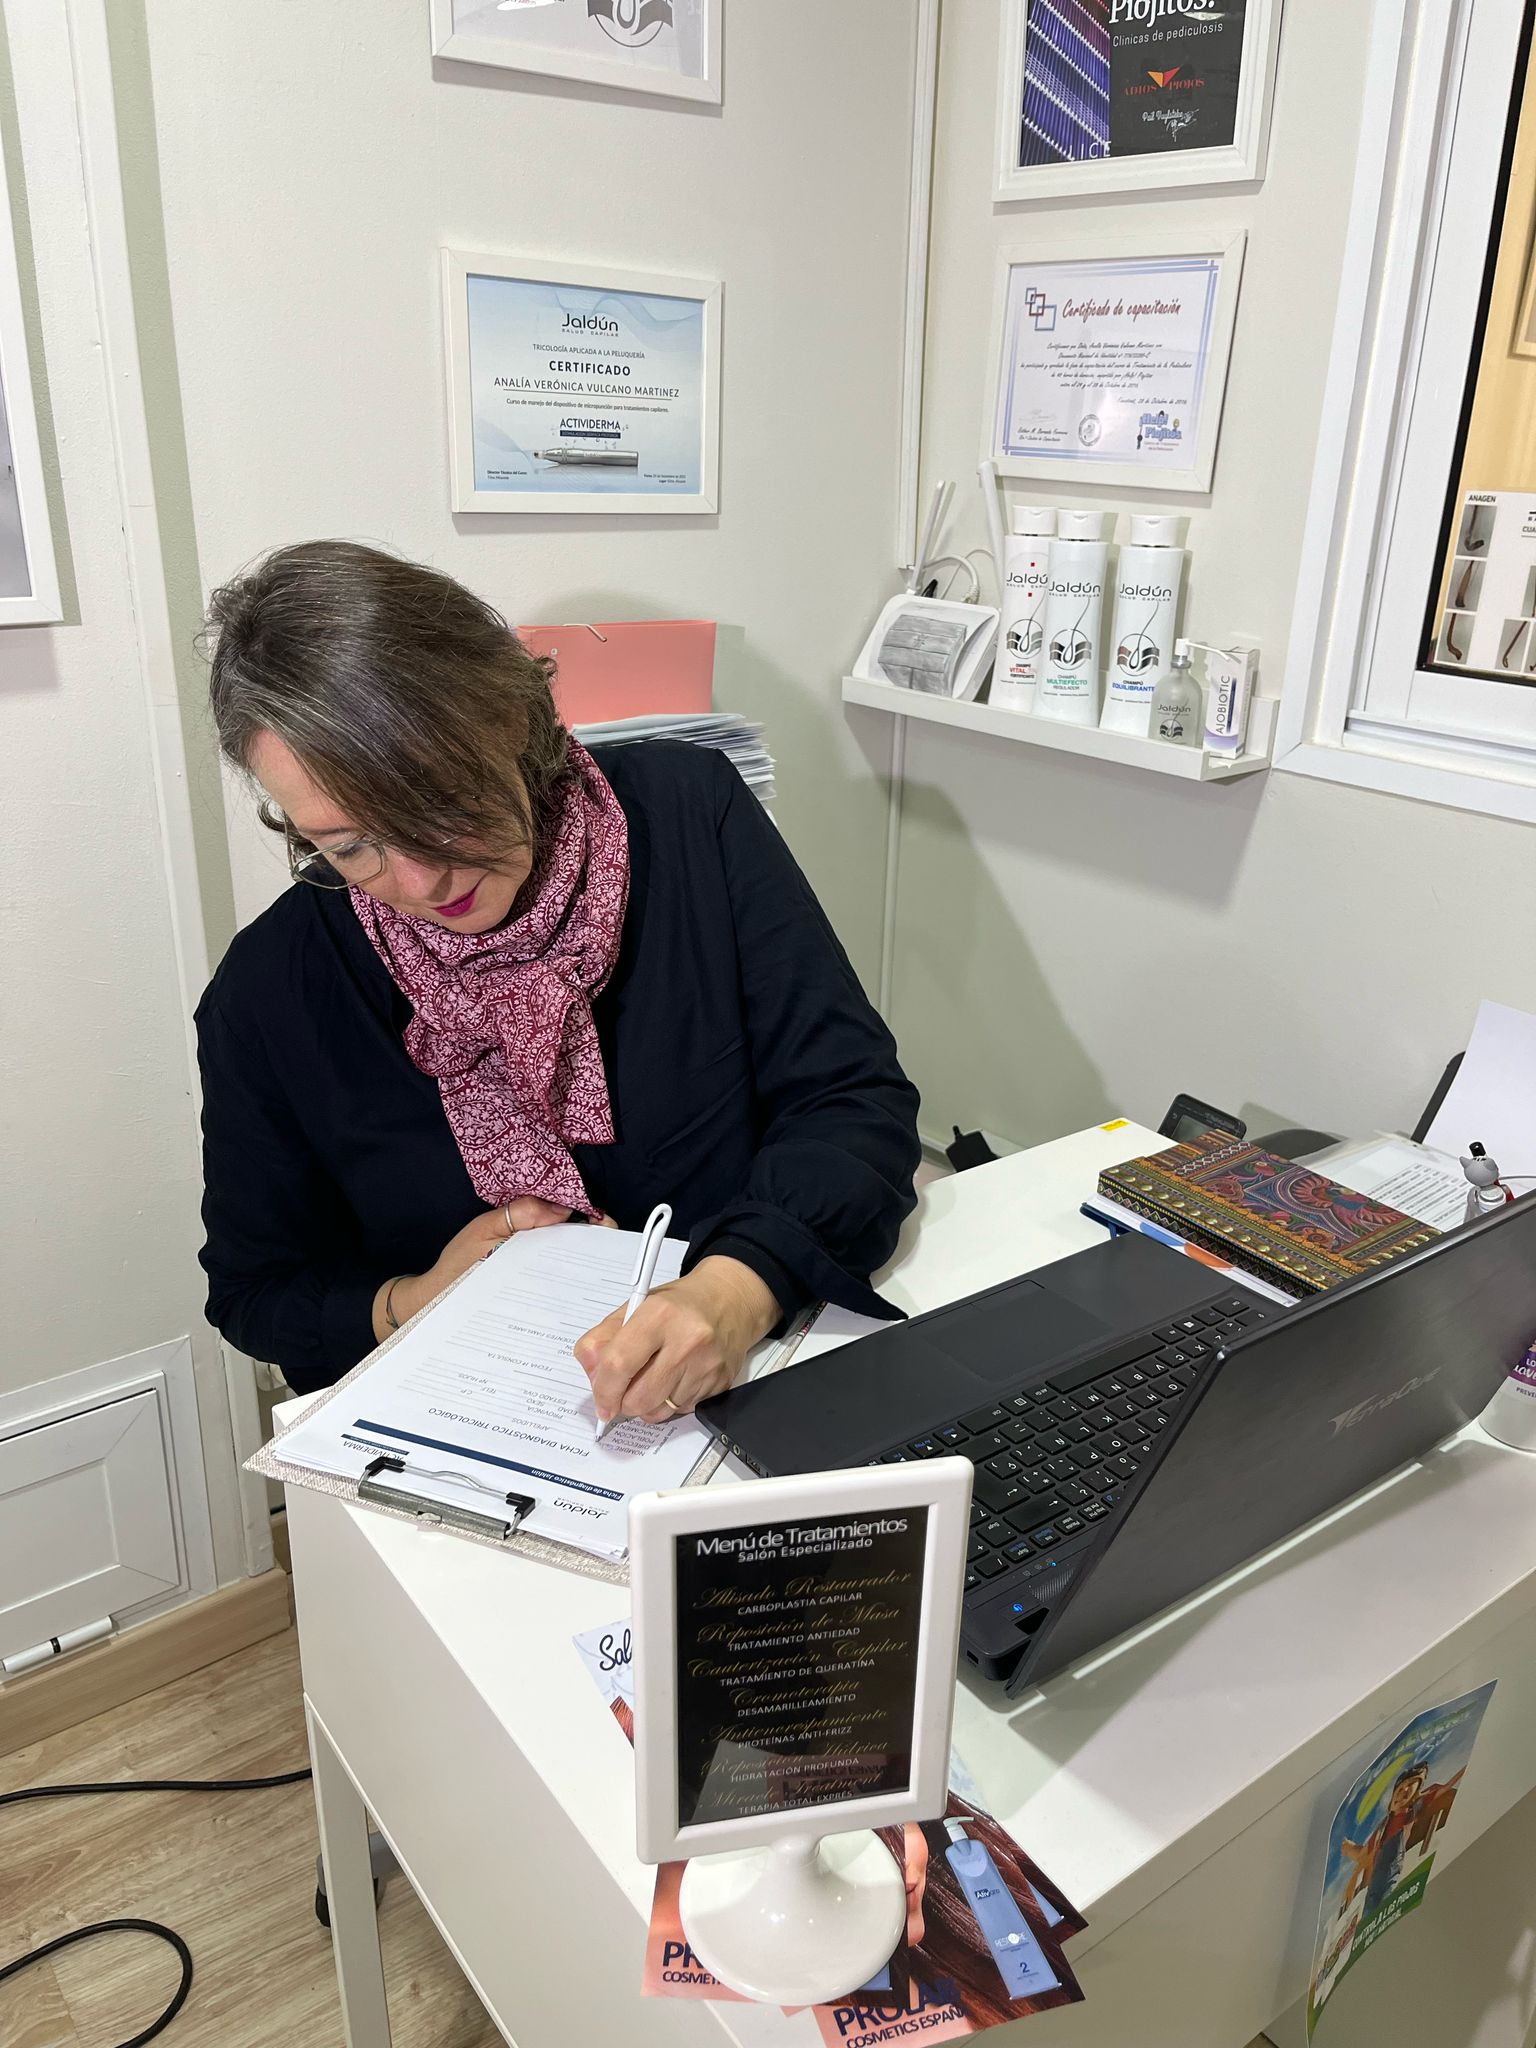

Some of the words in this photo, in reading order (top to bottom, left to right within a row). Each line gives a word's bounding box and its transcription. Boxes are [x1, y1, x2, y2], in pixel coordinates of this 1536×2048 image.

[1152, 30, 1163, 41] de
[1166, 22, 1223, 41] pediculosis
[1062, 298, 1111, 324] Certificado
[1113, 298, 1124, 315] de
[1126, 298, 1182, 324] capacitación
[561, 313, 619, 332] Jaldún
[533, 343, 568, 353] TRICOLOGÍA
[569, 347, 597, 355] APLICADA
[611, 350, 645, 359] PELUQUERÍA
[549, 360, 631, 376] CERTIFICADO
[494, 376, 531, 389] ANALÍA
[534, 378, 584, 392] VERÓNICA
[587, 383, 632, 395] VULCANO
[634, 386, 680, 397] MARTINEZ
[560, 418, 621, 431] ACTIVIDERMA
[1468, 495, 1497, 503] ANAGEN
[1006, 572, 1049, 584] Jaldú
[1049, 581, 1101, 594] Jaldún
[1119, 583, 1172, 598] Jaldún
[1046, 678, 1088, 686] MULTIEFECTO
[1157, 703, 1192, 713] Jaldún
[530, 1362, 553, 1373] FECHA
[526, 1398, 545, 1408] SEXO
[539, 1393, 568, 1405] ESTADO
[428, 1407, 490, 1432] TRICOLÓGICO
[527, 1406, 564, 1420] PROVINCIA
[558, 1406, 578, 1416] EDAD
[511, 1417, 550, 1432] APELLIDOS
[491, 1425, 558, 1449] DIAGNÓSTICO
[611, 1437, 651, 1450] DIRECCIÓN
[560, 1443, 591, 1458] FICHA
[617, 1445, 646, 1457] NOMBRE
[531, 1468, 555, 1481] Jaldún
[554, 1475, 594, 1493] diagnóstico
[593, 1486, 603, 1495] de
[602, 1489, 622, 1501] Ficha
[553, 1499, 608, 1519] Jaldún
[697, 1534, 757, 1557] Menú
[758, 1527, 784, 1547] de
[786, 1517, 908, 1544] Tratamientos
[738, 1547, 777, 1564] Salón
[780, 1536, 873, 1559] Especializado
[693, 1585, 776, 1609] Alisado
[784, 1569, 912, 1598] Restaurador
[737, 1597, 817, 1616] CARBOPLASTIA
[819, 1591, 863, 1606] CAPILAR
[697, 1617, 805, 1648] Reposición
[811, 1612, 834, 1629] de
[840, 1602, 901, 1625] Masa
[728, 1633, 804, 1652] TRATAMIENTO
[806, 1626, 861, 1642] ANTIEDAD
[599, 1628, 633, 1672] Sal
[832, 1638, 908, 1662] Capilar
[719, 1668, 796, 1688] TRATAMIENTO
[798, 1666, 813, 1677] DE
[815, 1658, 876, 1675] QUERATINA
[728, 1680, 861, 1708] Cromoterapia
[737, 1693, 857, 1718] DESAMARILLEAMIENTO
[737, 1733, 796, 1750] PROTEÍNAS
[797, 1725, 853, 1742] ANTI-FRIZZ
[730, 1763, 801, 1784] HIDRATACIÓN
[803, 1758, 860, 1774] PROFUNDA
[738, 1801, 781, 1816] TERAPIA
[783, 1796, 814, 1809] TOTAL
[816, 1790, 854, 1804] EXPRÉS
[1020, 1961, 1030, 1974] 2
[662, 1970, 721, 1985] COSME
[833, 1974, 963, 2036] PROLAB
[846, 2017, 920, 2048] COSMETICS
